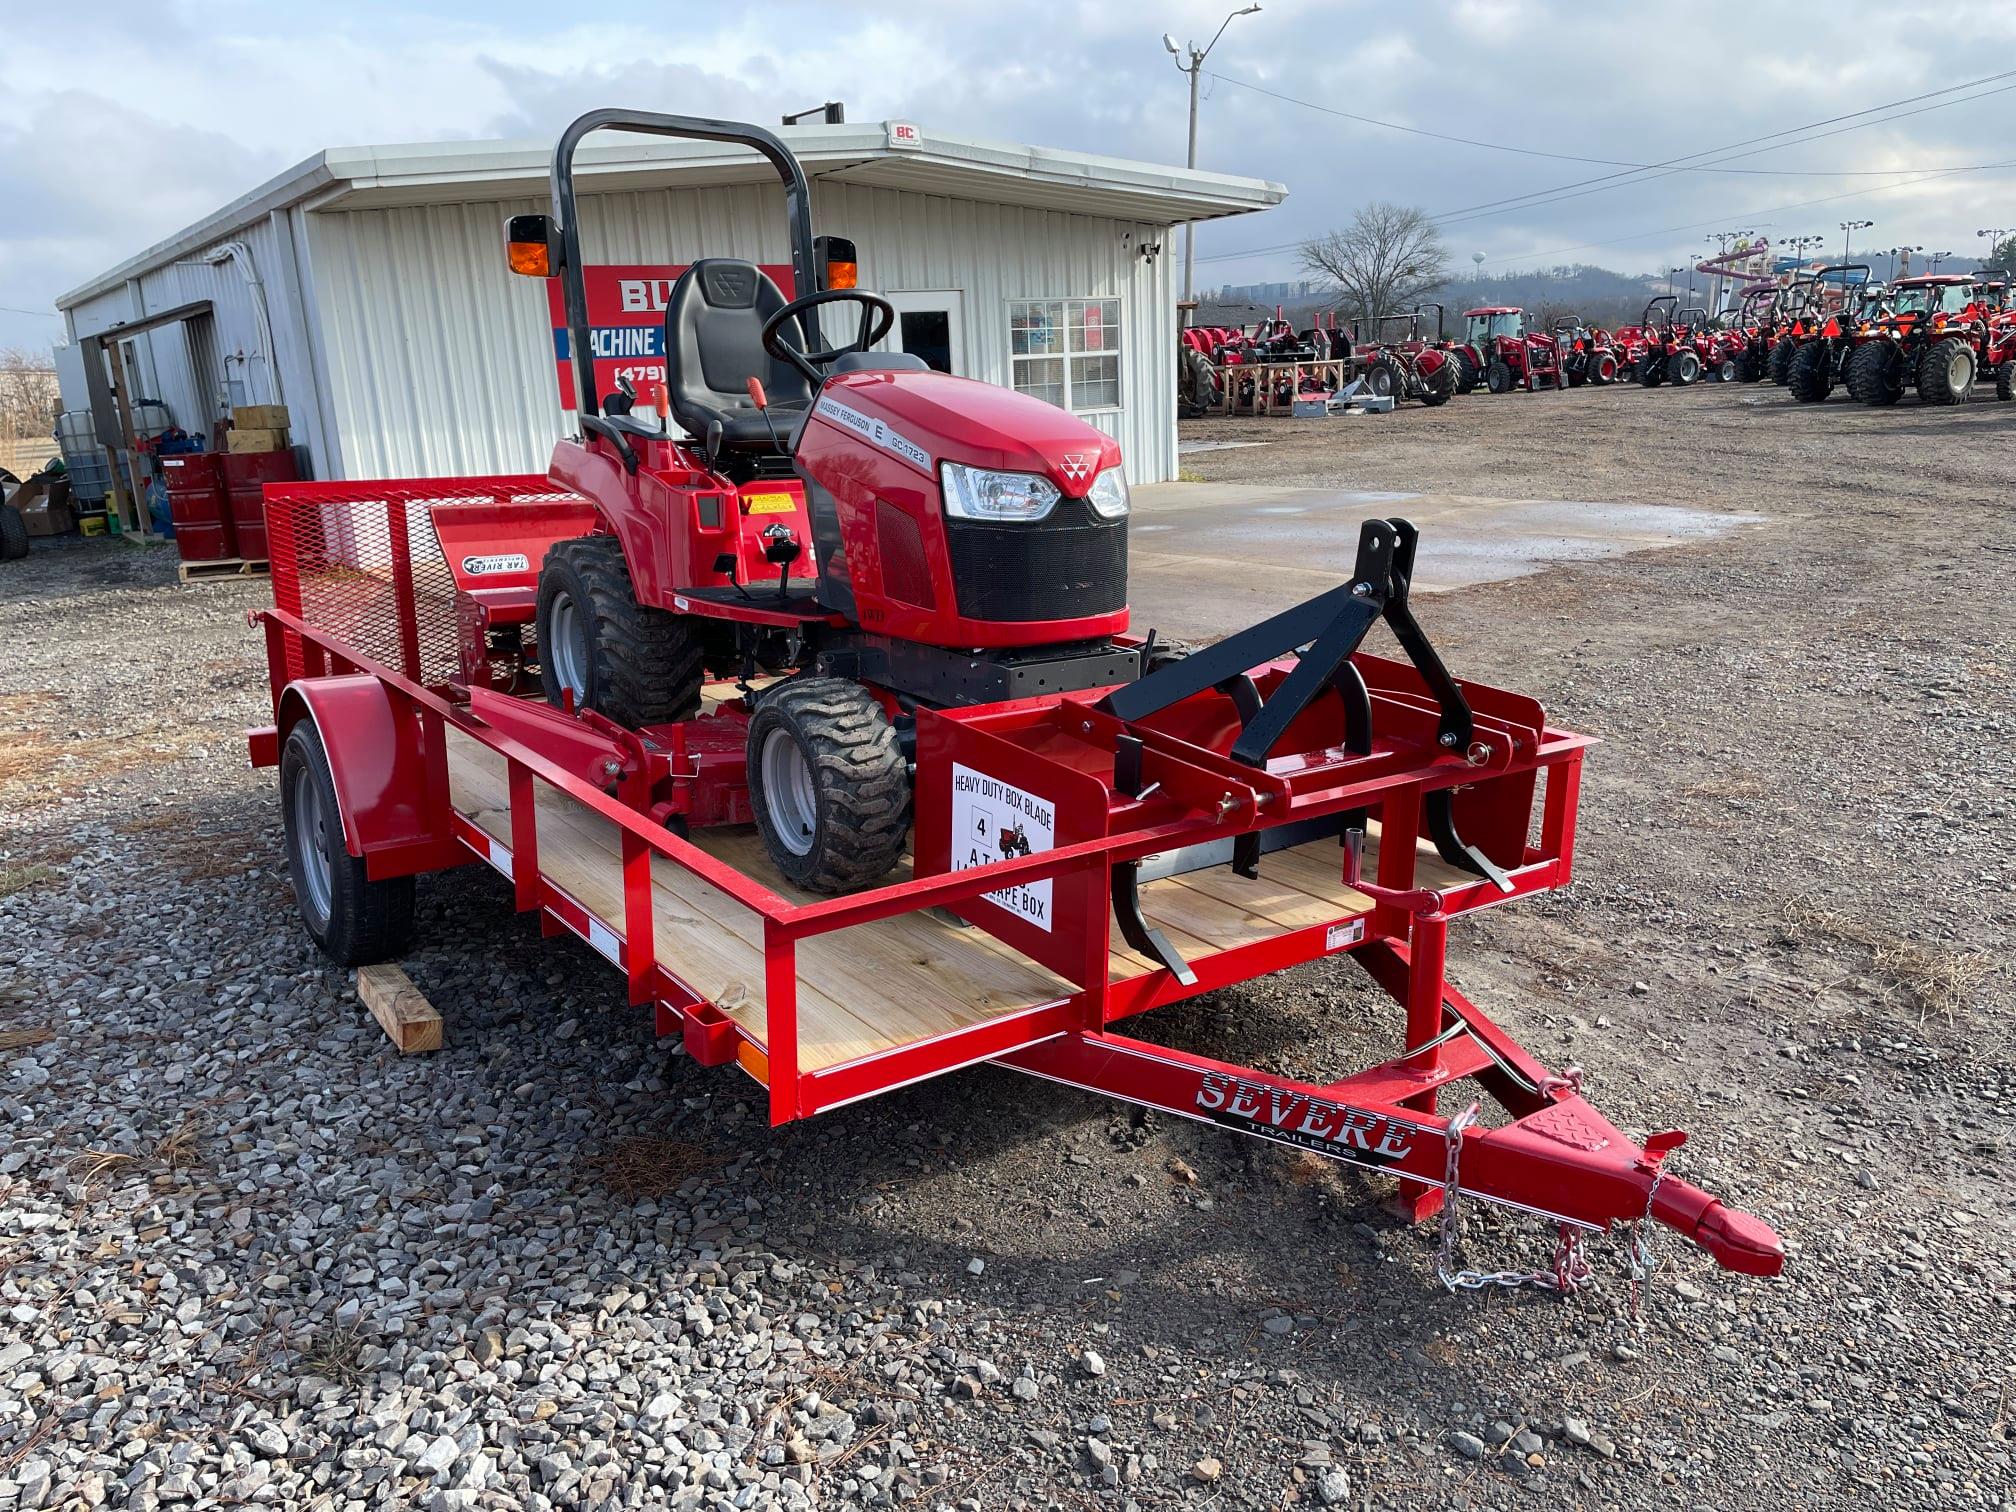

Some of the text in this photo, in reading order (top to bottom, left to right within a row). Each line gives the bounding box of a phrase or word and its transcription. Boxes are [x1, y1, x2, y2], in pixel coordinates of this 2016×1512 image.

[897, 127, 913, 138] BC
[569, 328, 655, 357] ACHINE
[820, 401, 840, 416] MASSEY
[840, 410, 871, 431] FERGUSON
[875, 425, 883, 439] E
[955, 775, 1051, 831] HEAVY DUTY BOX BLADE
[977, 818, 986, 836] 4
[1022, 892, 1044, 920] BOX
[1196, 1070, 1417, 1159] SEVERE
[1246, 1121, 1357, 1158] TRAILERS
